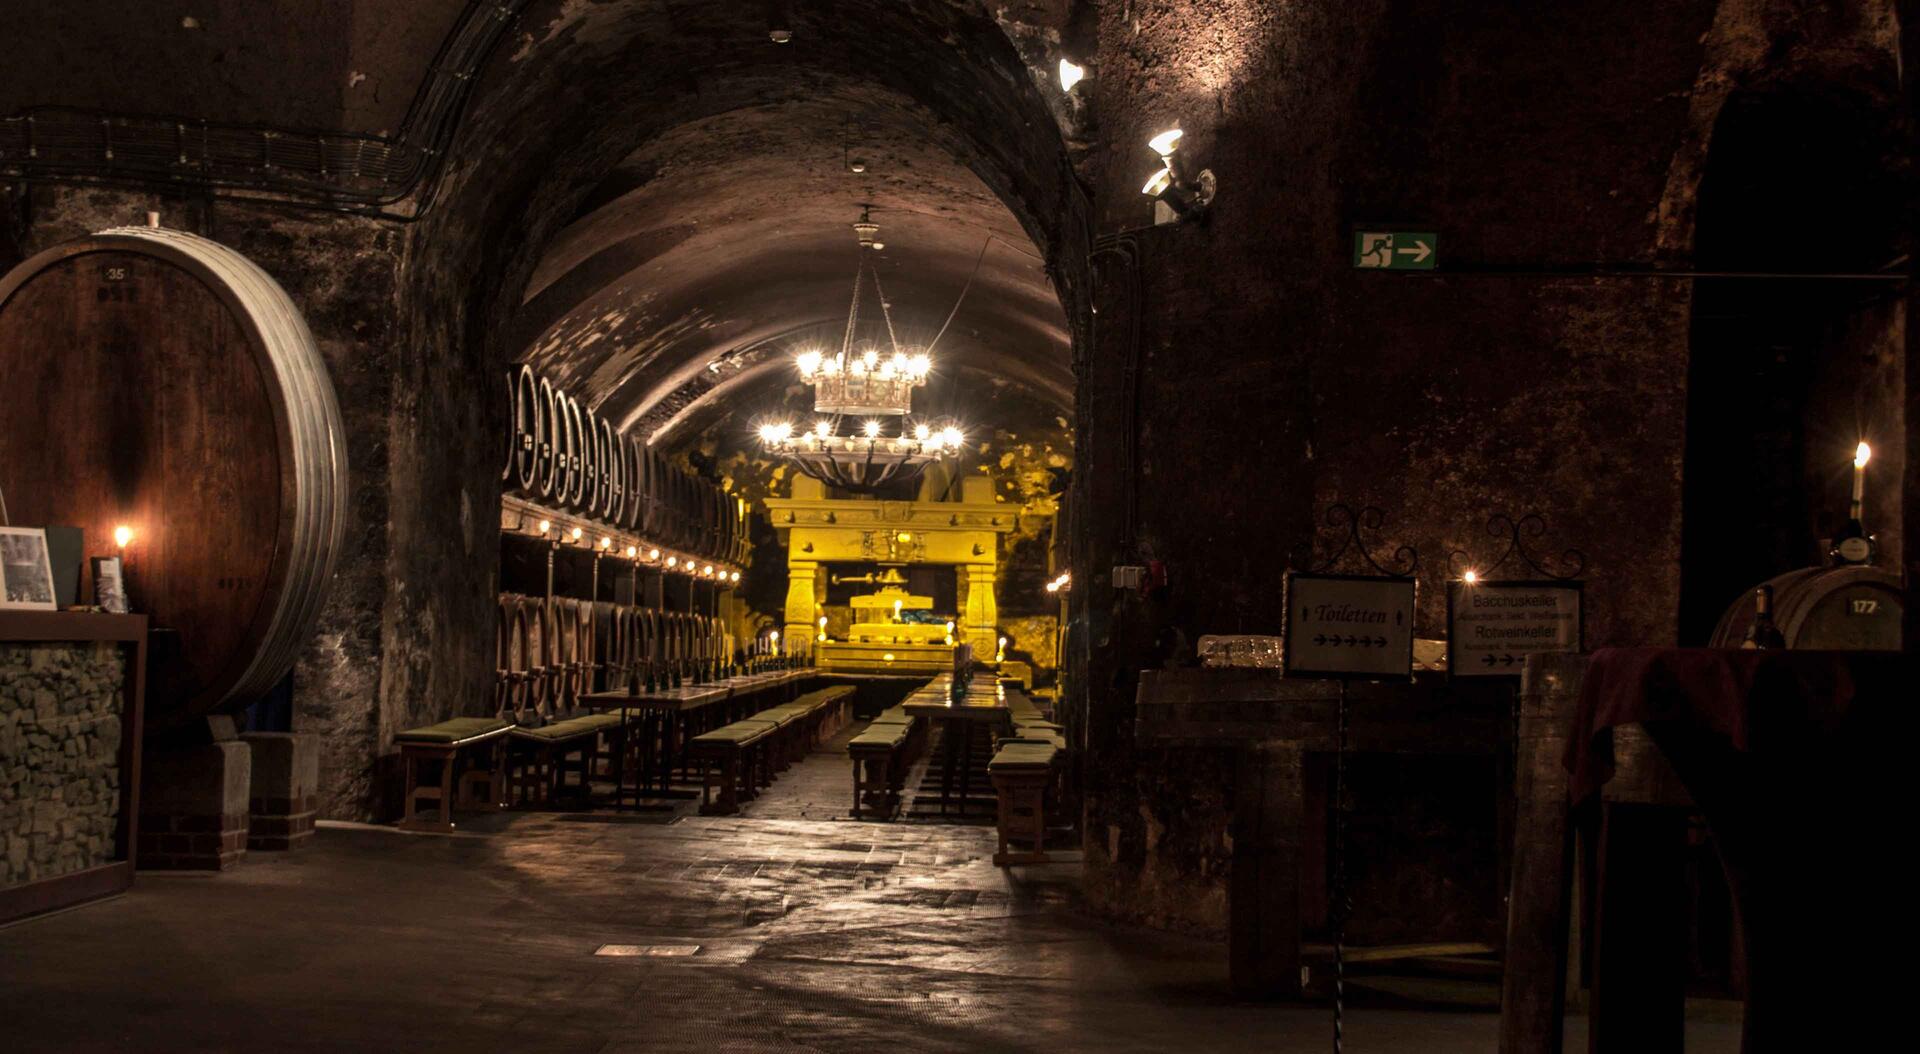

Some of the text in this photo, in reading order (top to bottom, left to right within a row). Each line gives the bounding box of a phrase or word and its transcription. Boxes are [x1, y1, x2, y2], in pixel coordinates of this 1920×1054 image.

[108, 268, 125, 280] 35
[1473, 594, 1557, 608] Bacchuskeller
[1853, 598, 1877, 613] 177
[1314, 604, 1387, 623] Toiletten
[1475, 625, 1556, 638] Rotweinkeller
